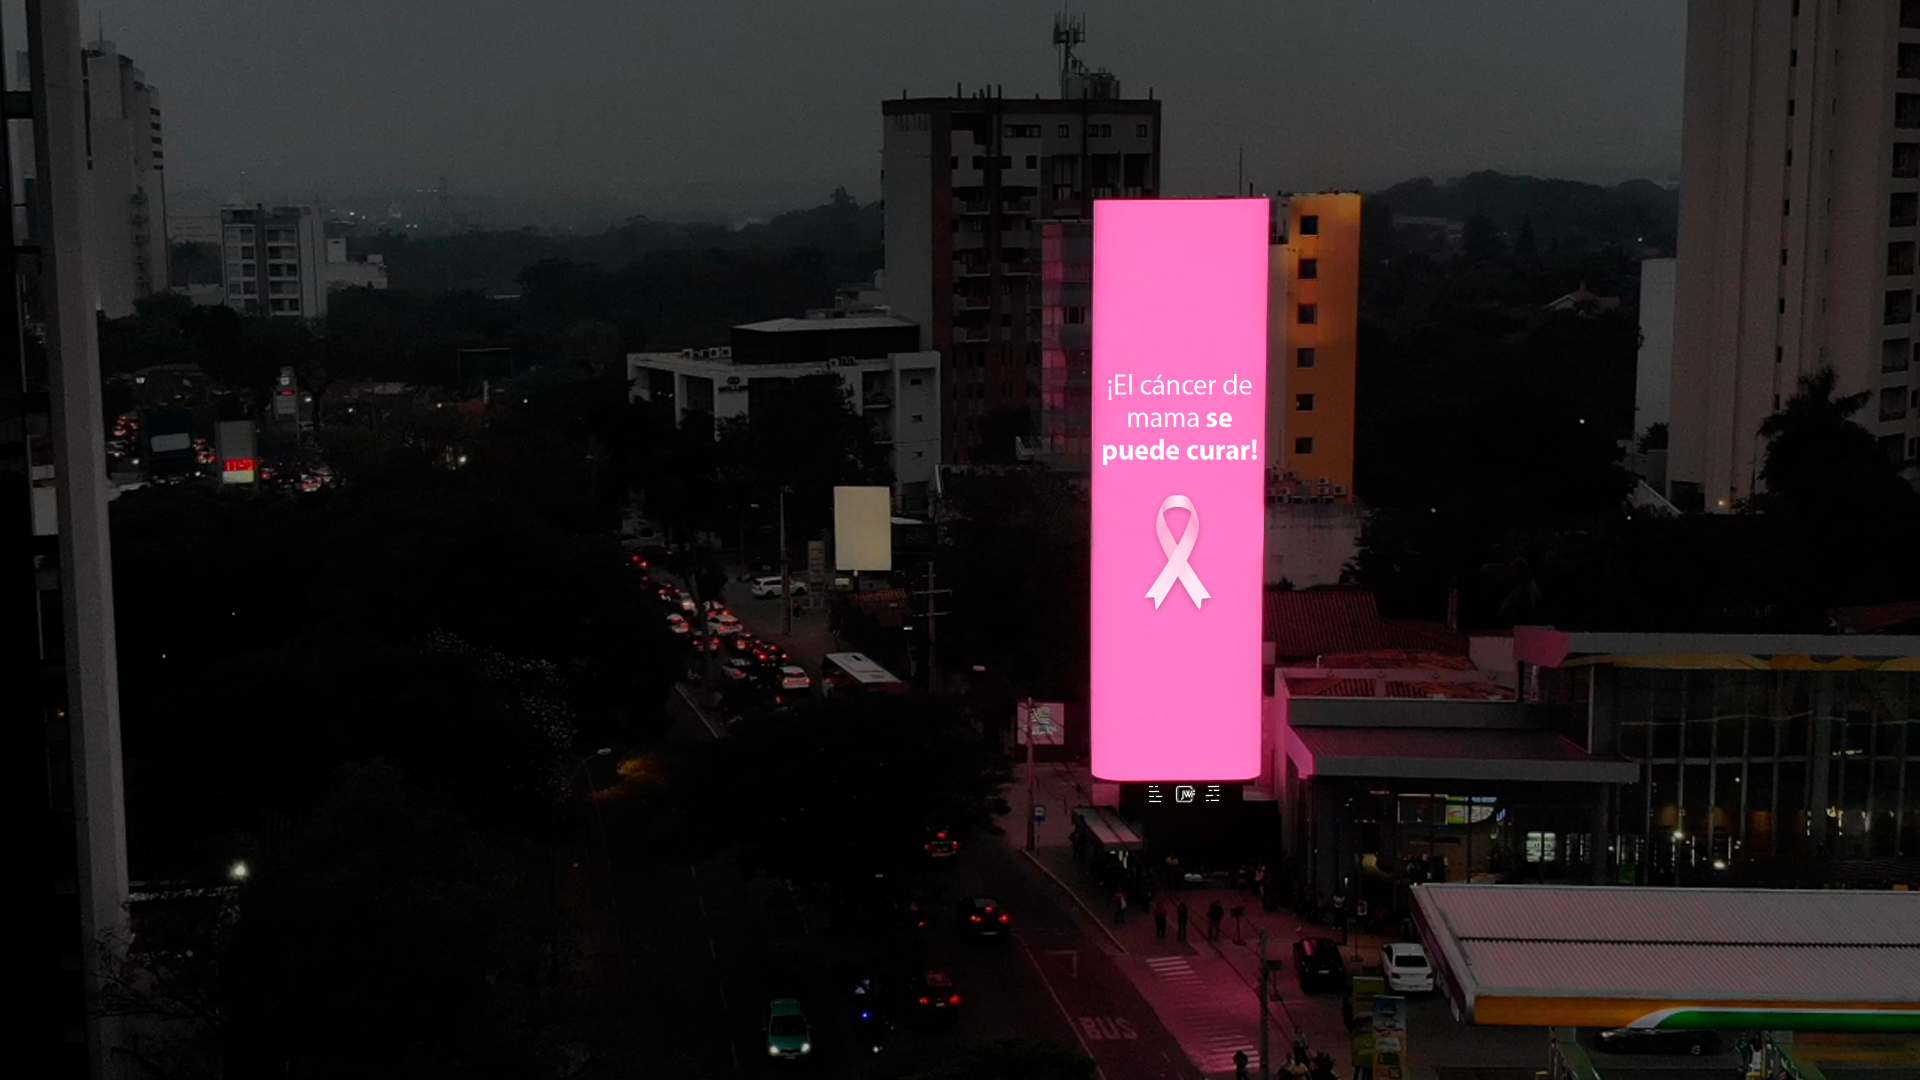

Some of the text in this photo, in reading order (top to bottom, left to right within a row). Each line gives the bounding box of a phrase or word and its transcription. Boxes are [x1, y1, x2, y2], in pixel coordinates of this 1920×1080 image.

[1107, 373, 1253, 400] ¡El cáncer de
[1127, 411, 1233, 428] mama se
[1102, 439, 1258, 465] puede curar!
[1078, 1016, 1138, 1040] BUS
